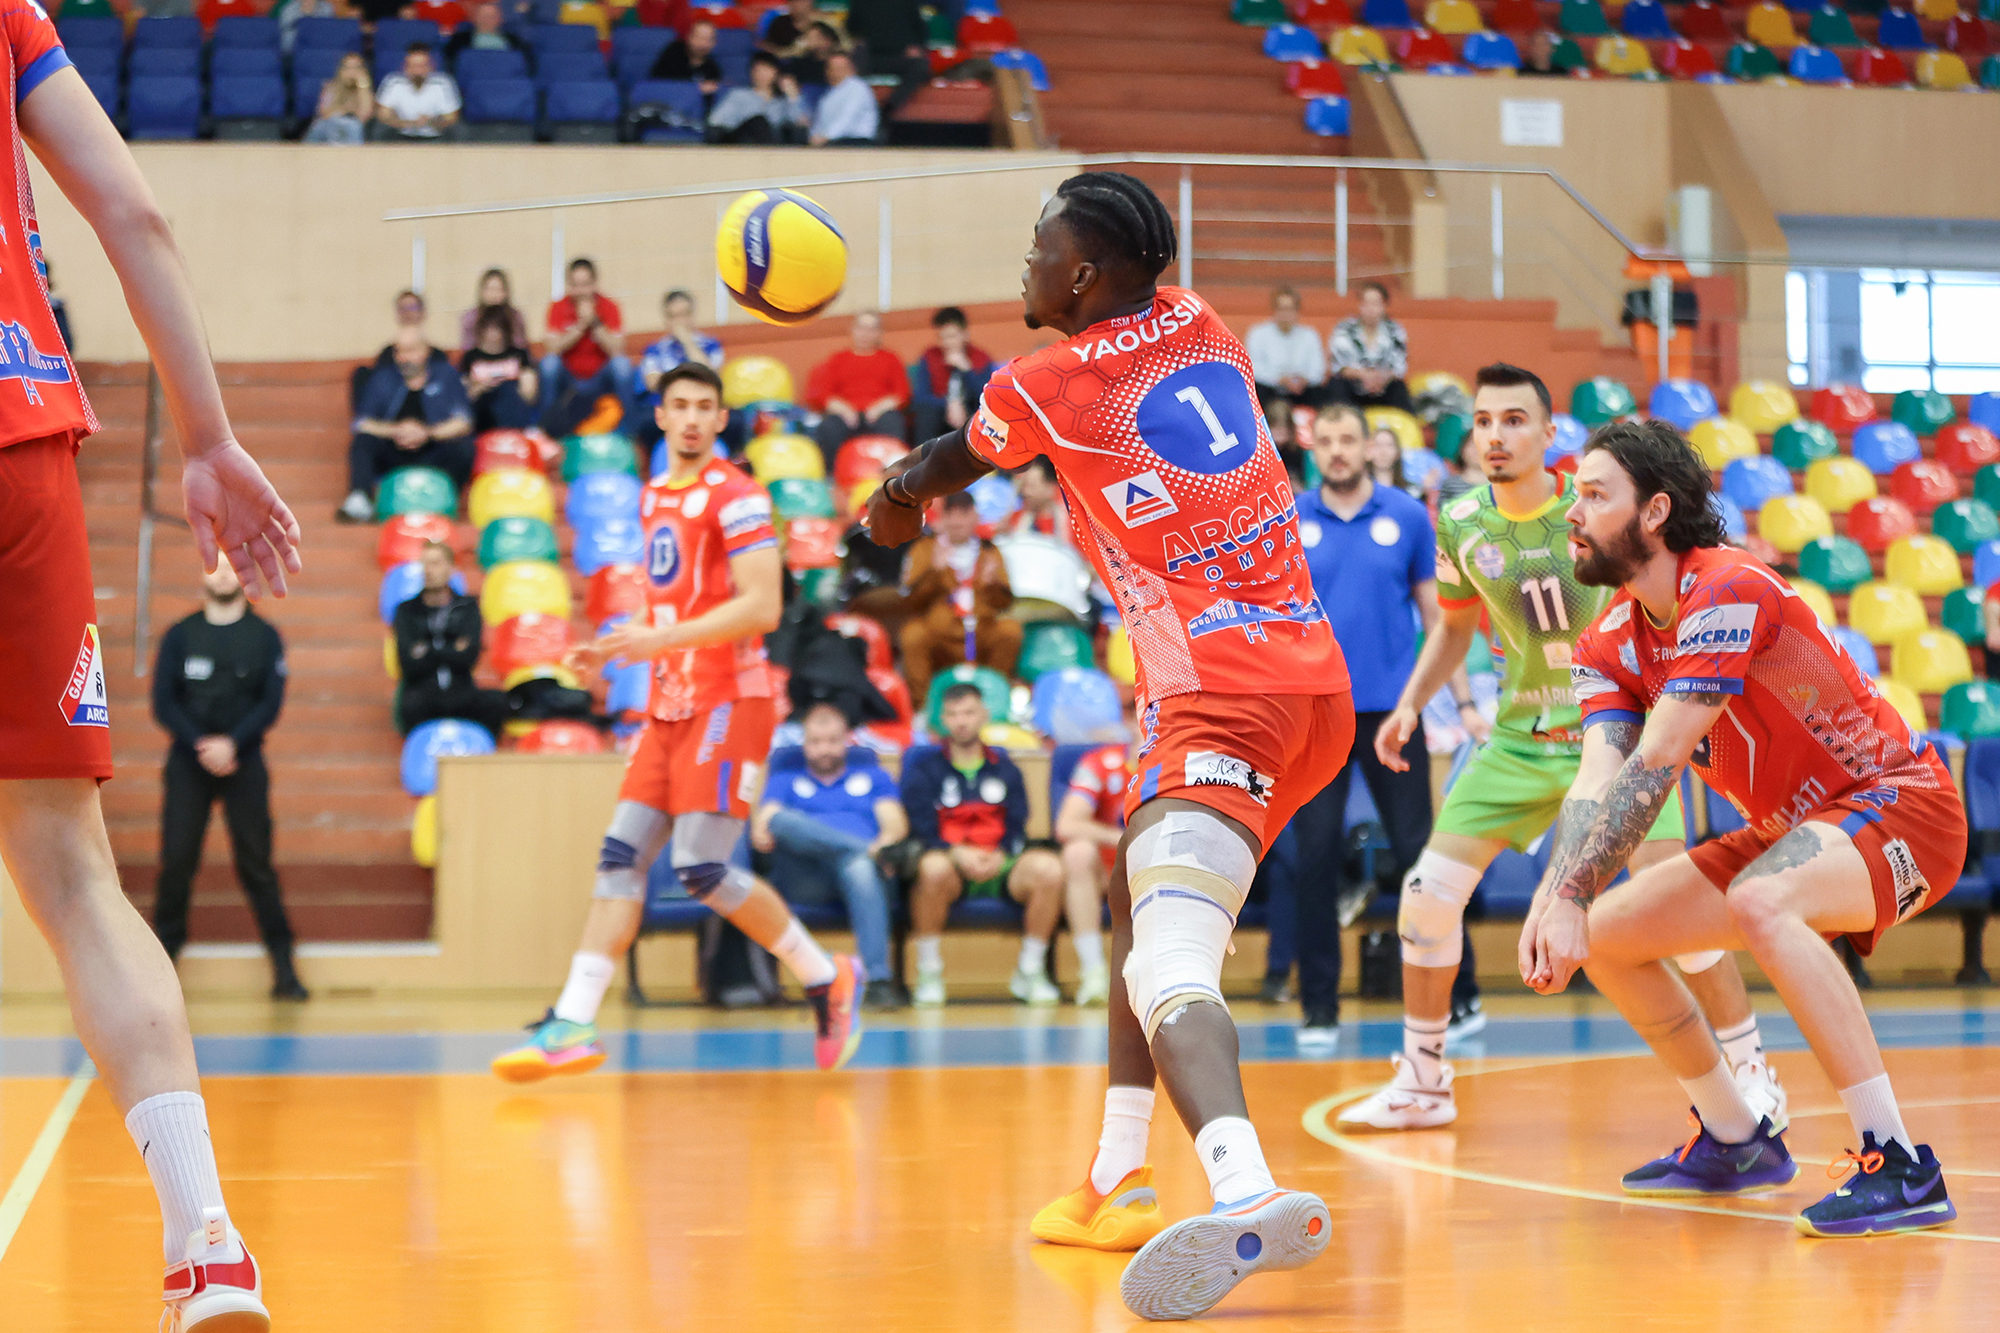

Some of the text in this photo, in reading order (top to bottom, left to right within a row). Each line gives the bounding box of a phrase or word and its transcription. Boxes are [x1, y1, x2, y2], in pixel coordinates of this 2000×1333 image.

[1111, 318, 1130, 328] CSM
[1175, 386, 1239, 456] 1
[1152, 507, 1176, 519] ARCADA
[1162, 481, 1297, 573] ARCAD
[1521, 576, 1570, 631] 11
[68, 645, 92, 700] GALATI
[1675, 682, 1721, 692] CSM ARCADA
[1804, 713, 1865, 776] COMPAN
[1893, 846, 1911, 885] AMIRO
